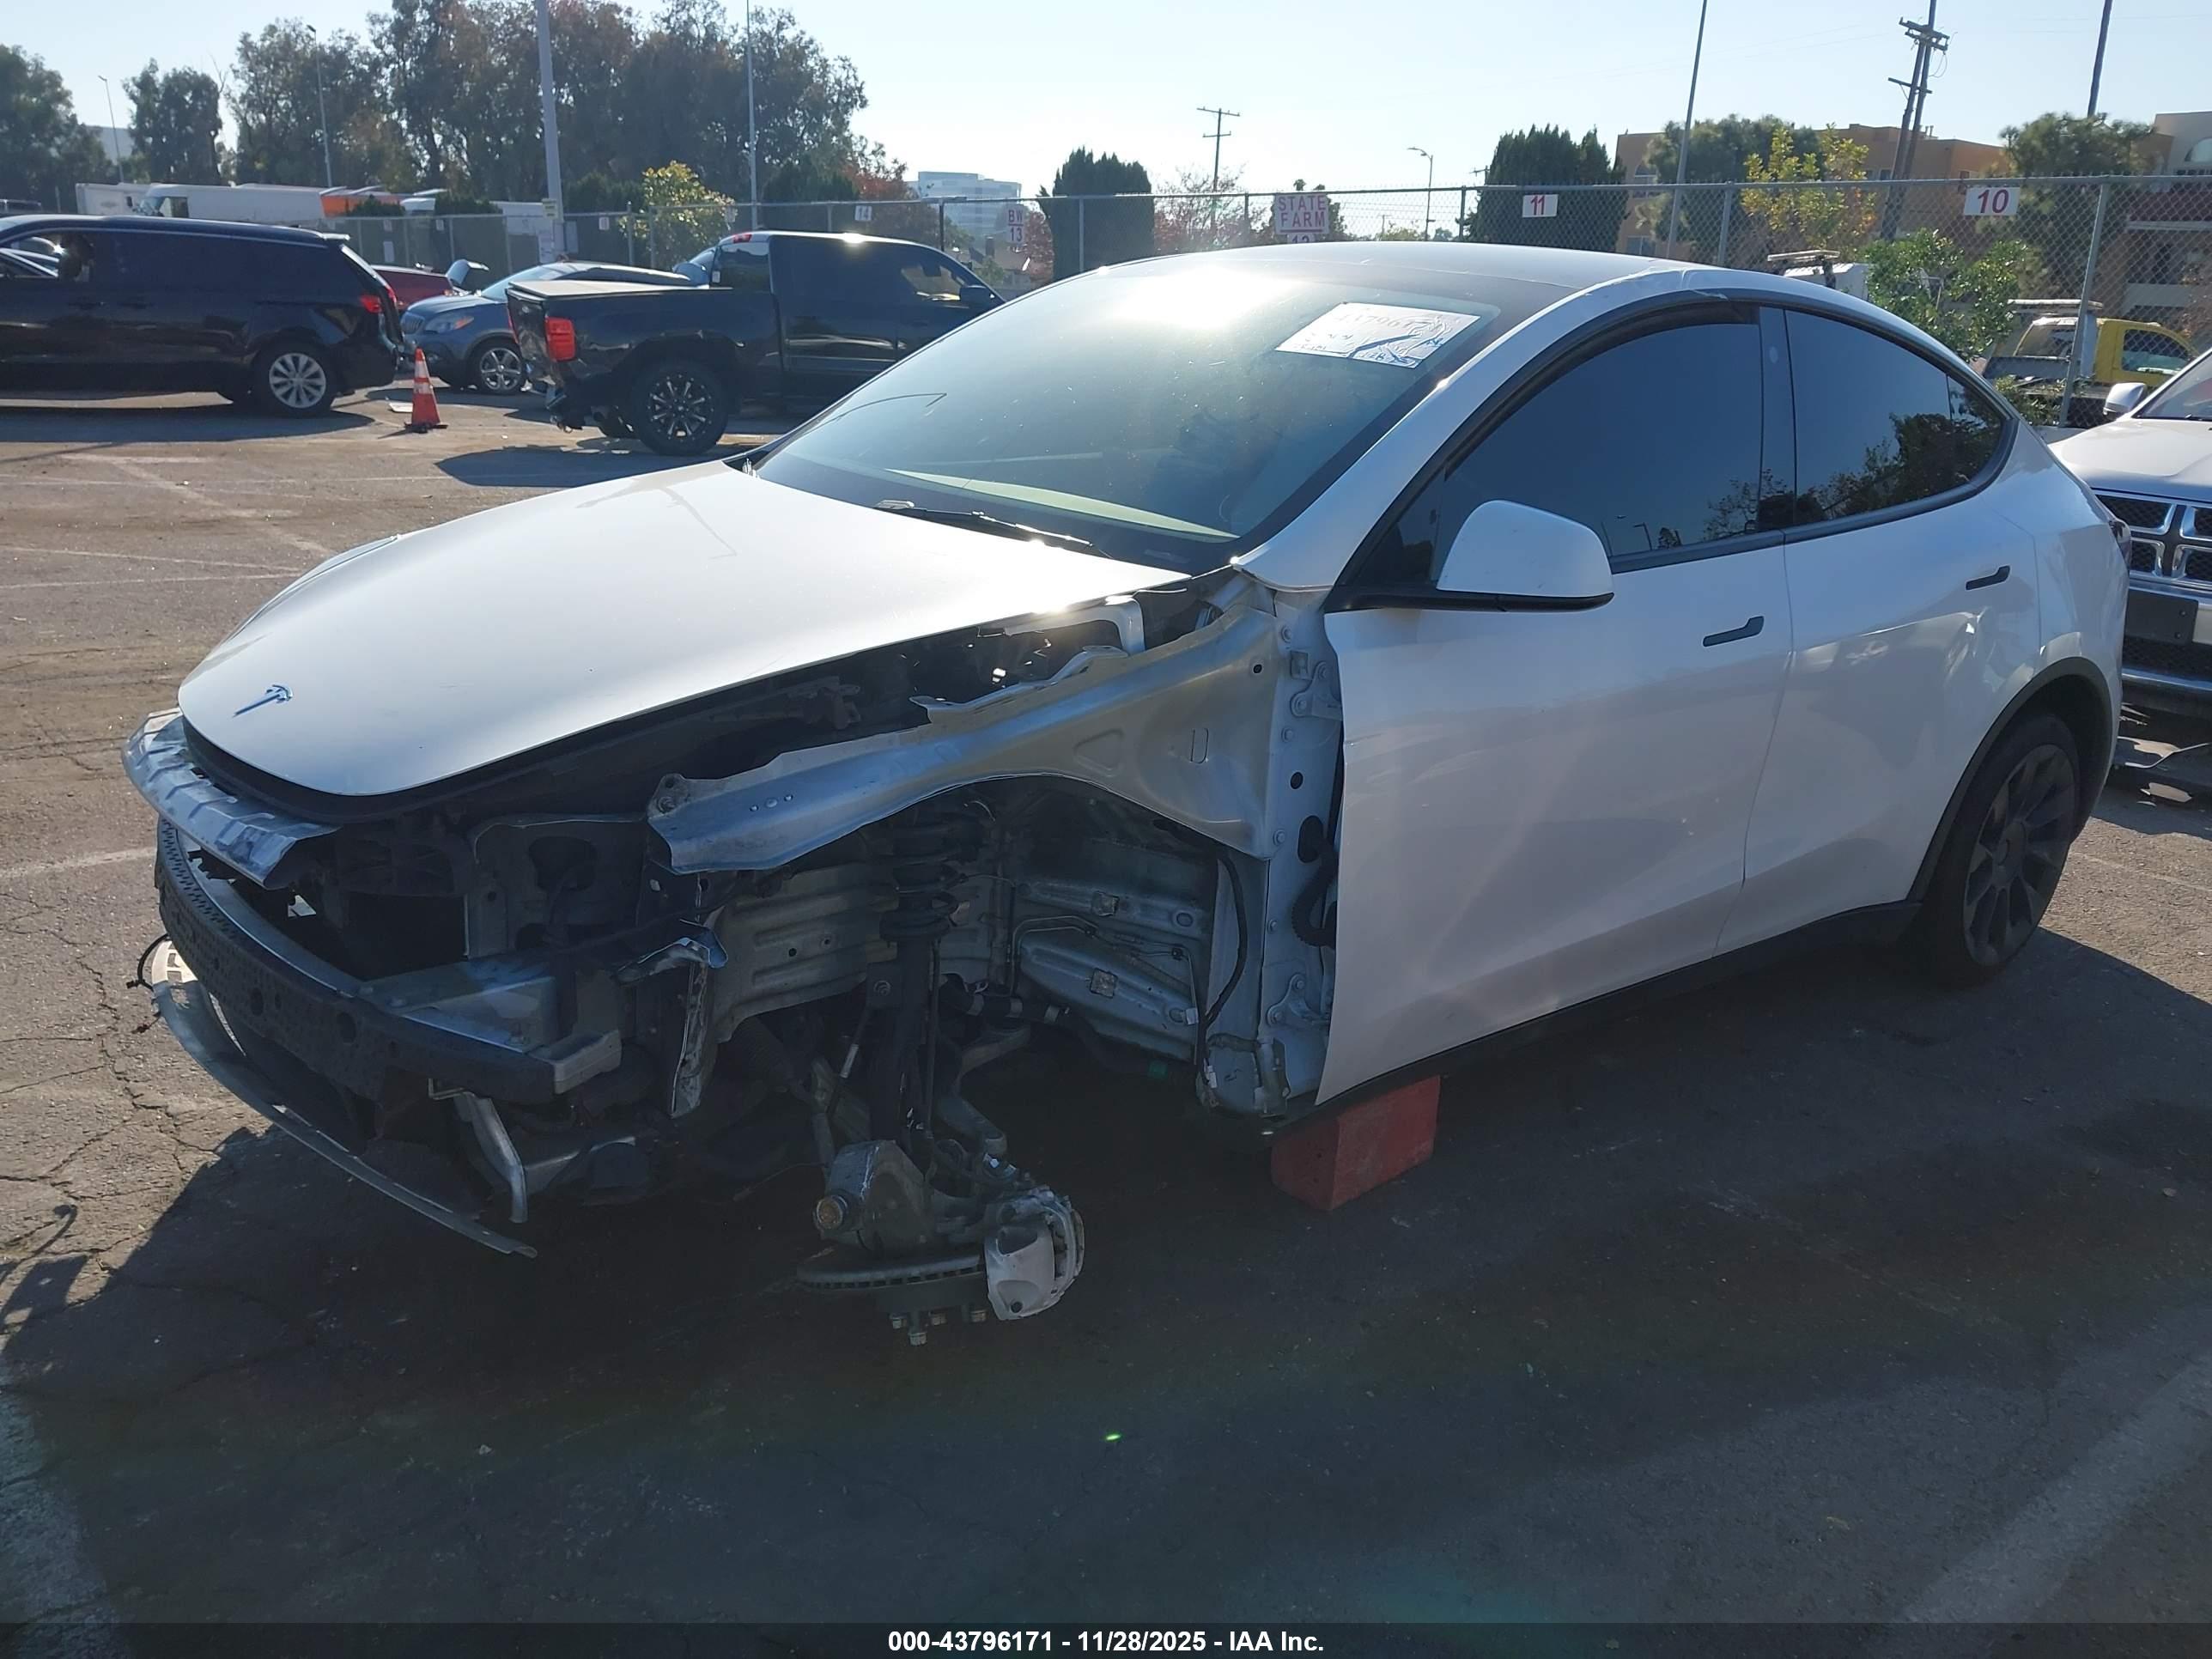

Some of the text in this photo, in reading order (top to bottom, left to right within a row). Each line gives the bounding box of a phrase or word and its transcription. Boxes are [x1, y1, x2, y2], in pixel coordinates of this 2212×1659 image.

[1278, 196, 1326, 211] STATE
[1530, 195, 1545, 216] 11
[1978, 189, 2009, 214] 10
[1008, 210, 1023, 223] BW
[1280, 211, 1326, 228] FARM
[1011, 227, 1022, 241] 13
